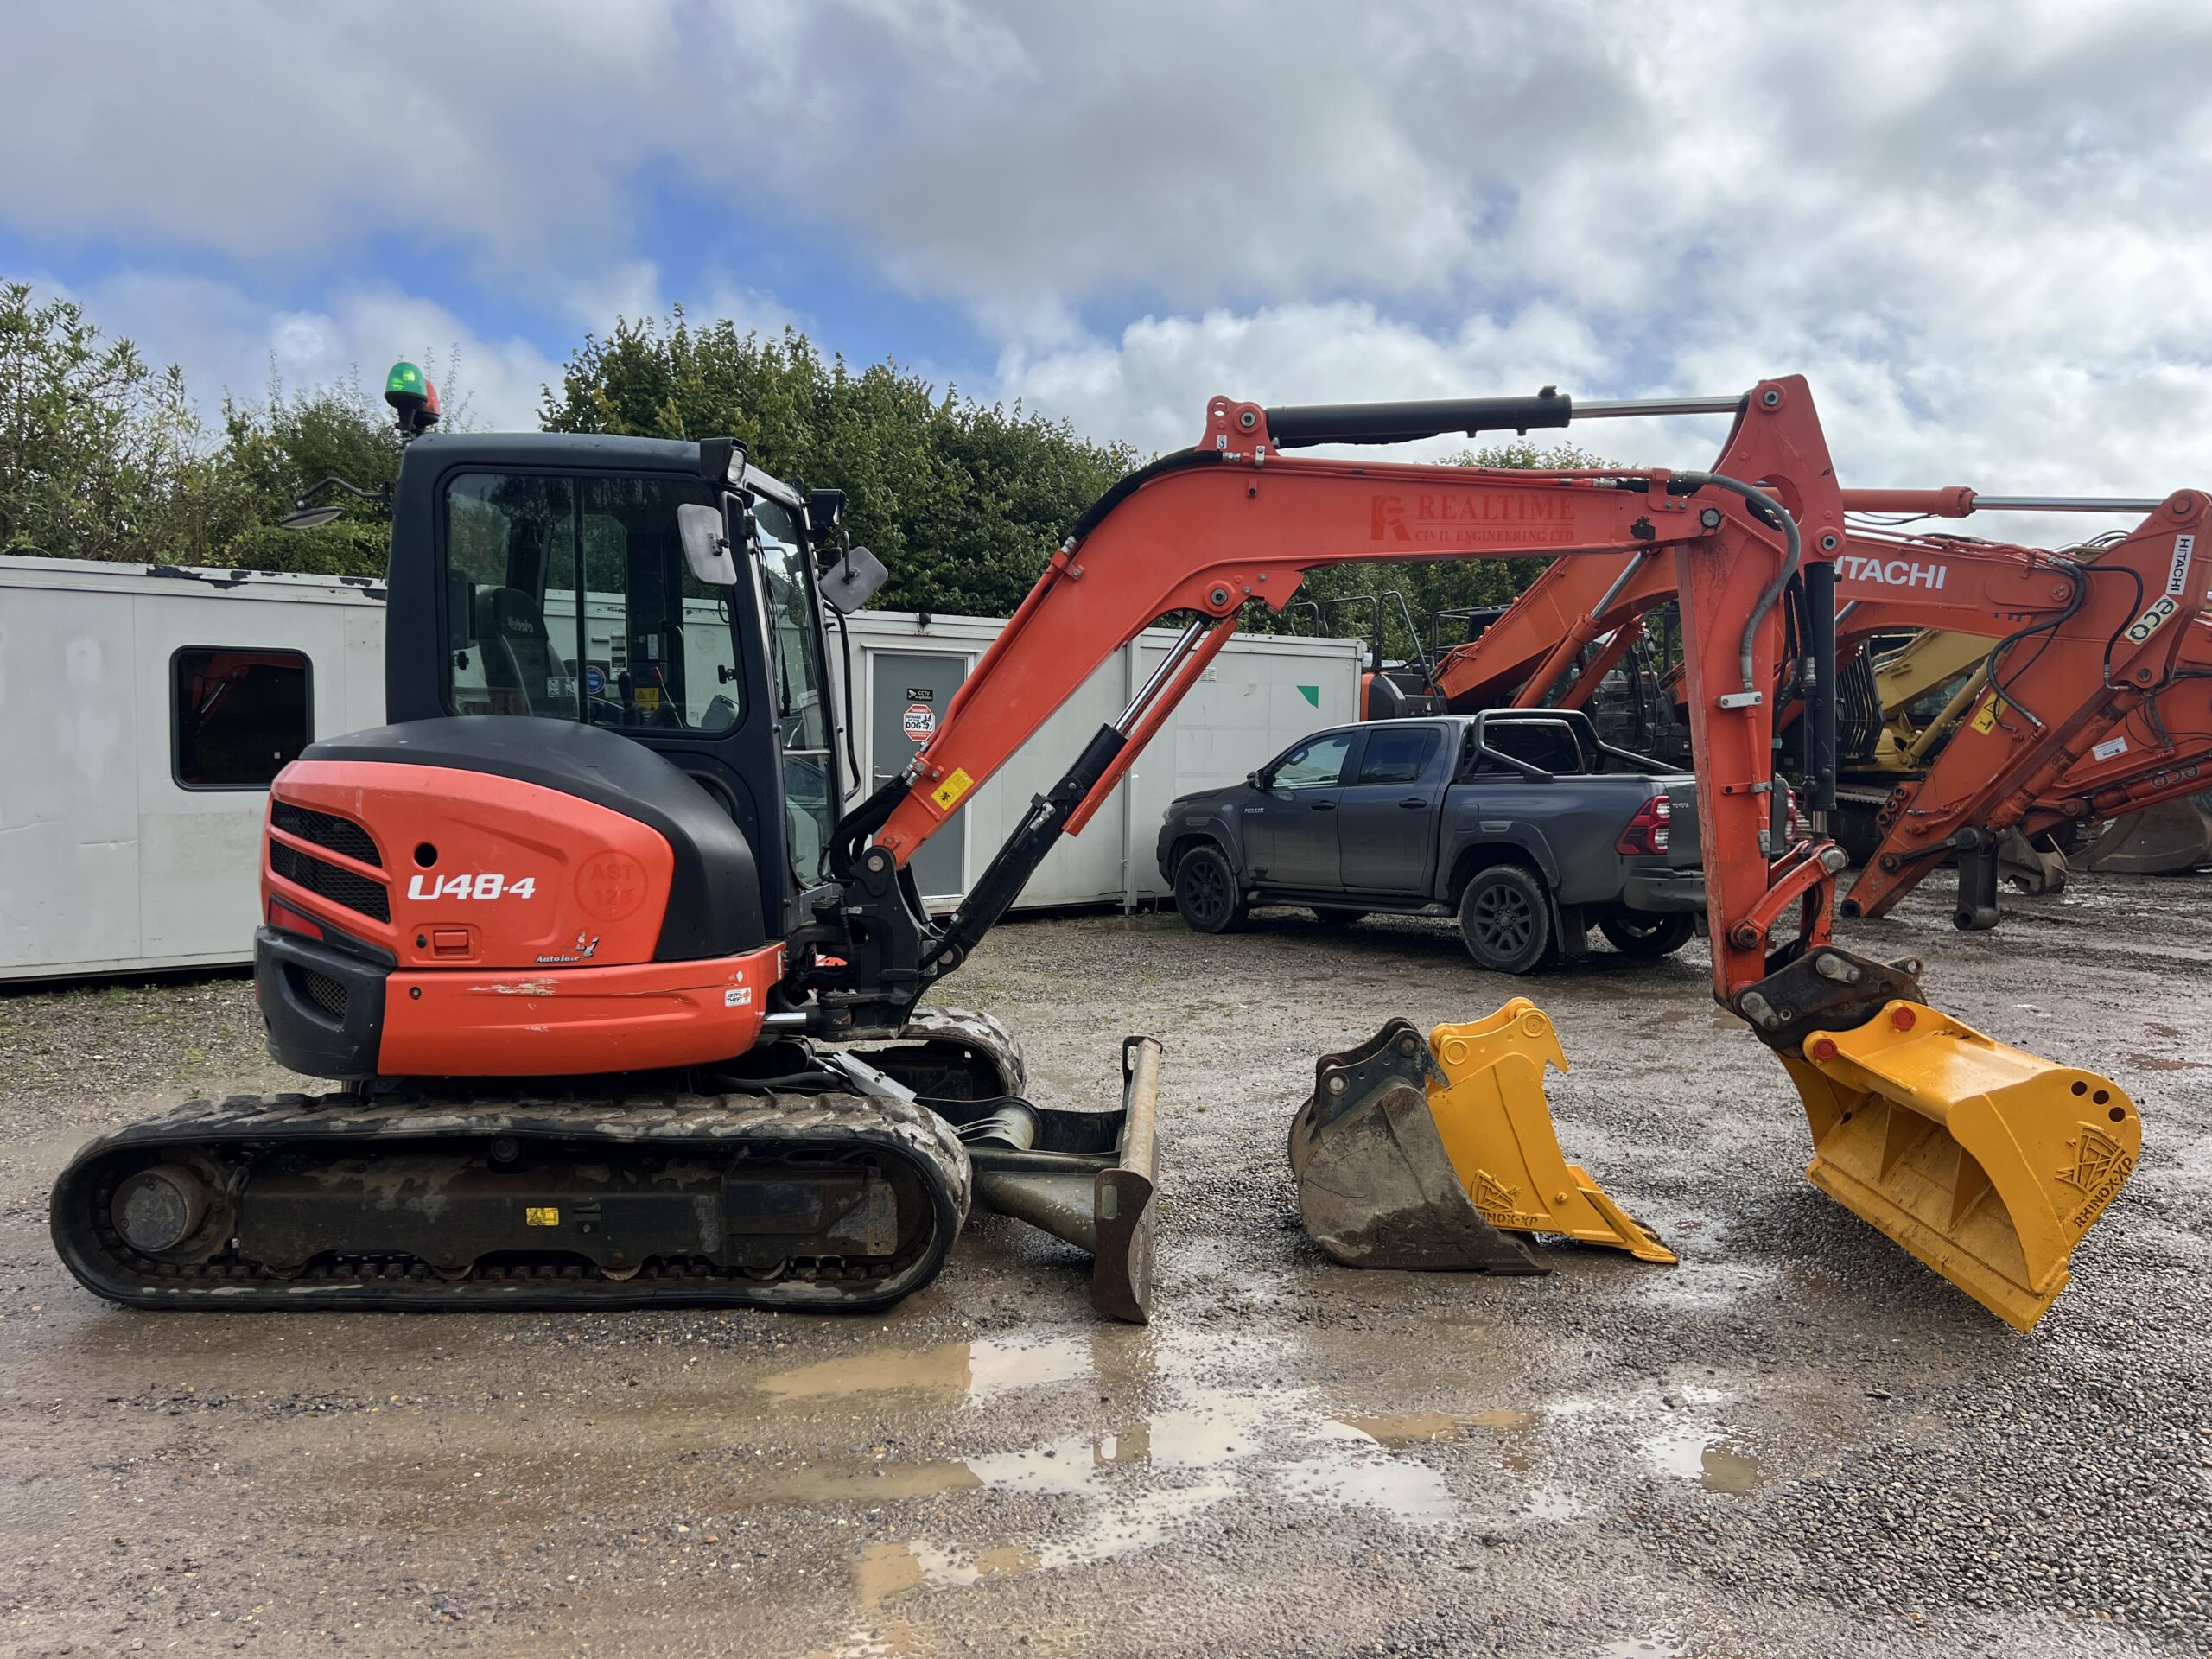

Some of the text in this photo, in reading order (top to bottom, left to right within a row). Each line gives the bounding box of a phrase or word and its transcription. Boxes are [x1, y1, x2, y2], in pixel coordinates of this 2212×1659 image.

[1417, 494, 1575, 520] REALTIME
[1415, 530, 1574, 542] CIVIL ENGINEERING LTD
[1834, 555, 1947, 589] ITACHI
[2170, 538, 2190, 592] HITACHI
[589, 863, 636, 881] AST
[407, 874, 536, 900] U48-4
[1479, 1211, 1538, 1227] INOX-XP
